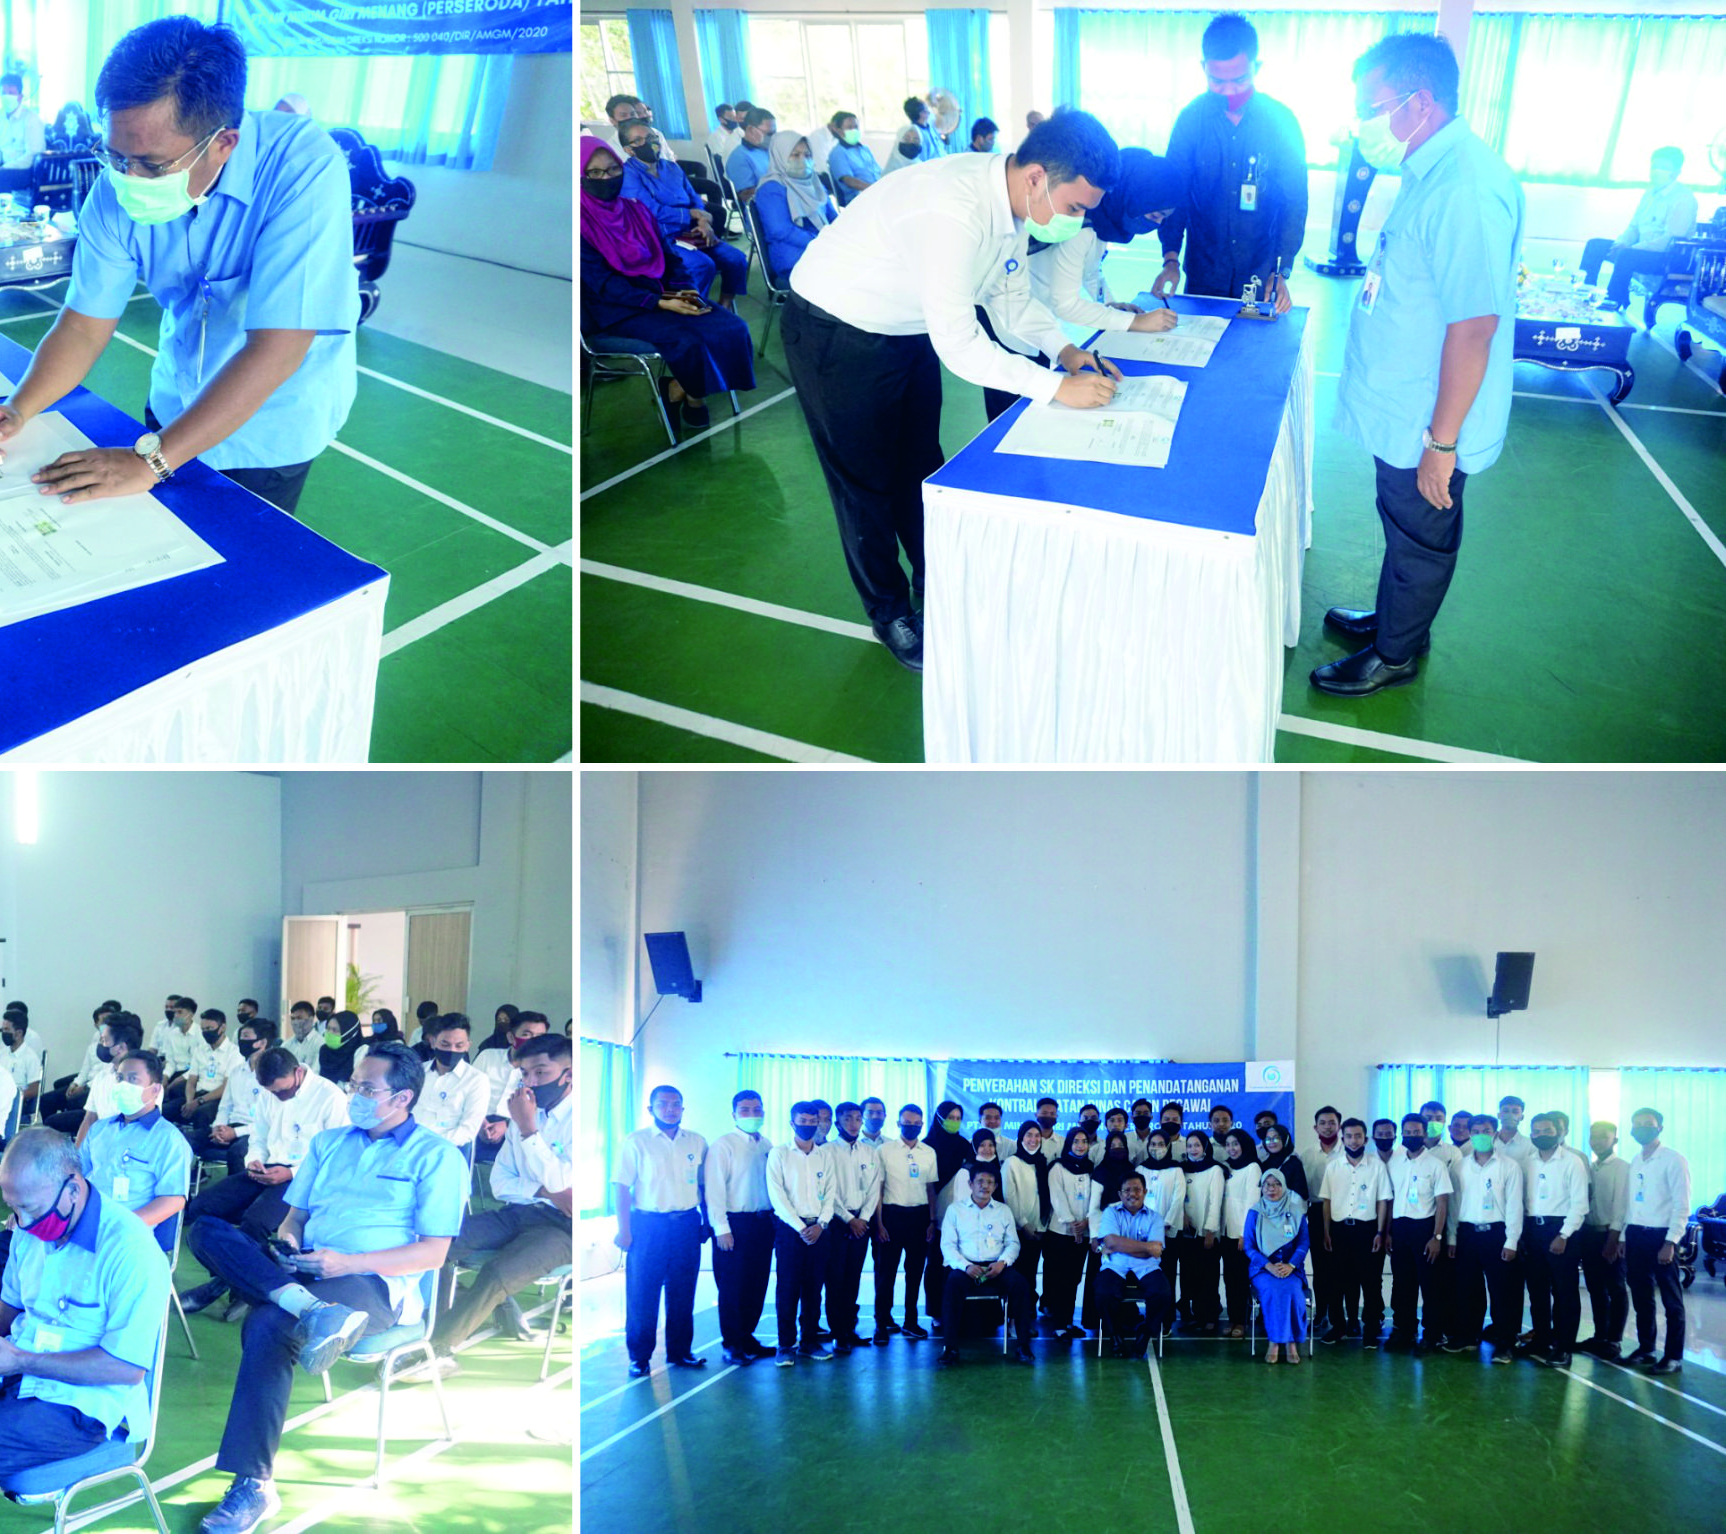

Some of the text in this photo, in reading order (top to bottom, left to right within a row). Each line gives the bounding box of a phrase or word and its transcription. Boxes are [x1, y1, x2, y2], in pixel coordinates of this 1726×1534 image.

[963, 1078, 1239, 1094] PENYERAHAN SK DIREKSI DAN PENANDATANGANAN
